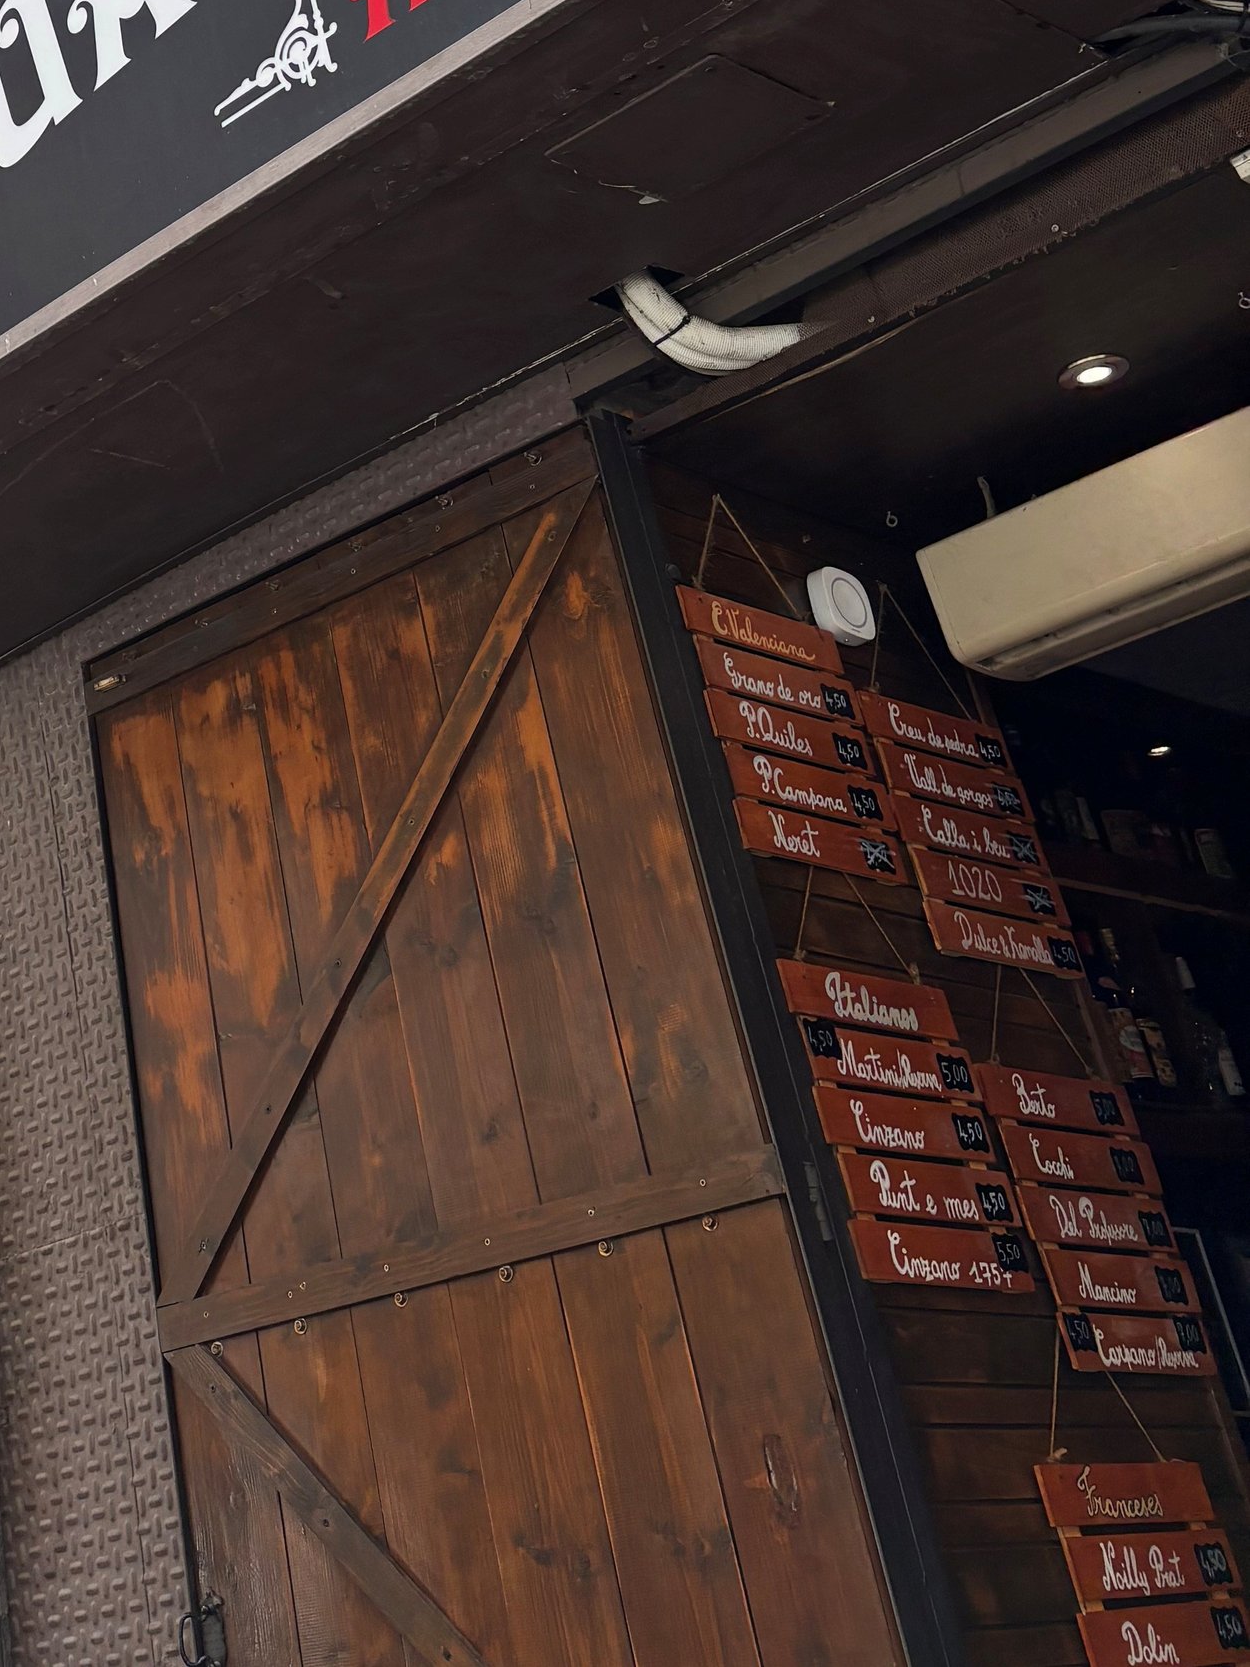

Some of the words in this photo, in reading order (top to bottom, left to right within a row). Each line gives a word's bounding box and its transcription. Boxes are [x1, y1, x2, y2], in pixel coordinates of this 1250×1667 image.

[777, 674, 795, 701] de
[799, 690, 821, 709] oro
[825, 692, 848, 711] 4,50
[926, 717, 945, 748] de
[838, 740, 860, 761] 4,50
[979, 741, 1002, 760] 4,50
[938, 764, 957, 798] de
[852, 794, 876, 814] 4,50
[768, 810, 821, 858] Neret
[970, 830, 982, 854] i
[948, 859, 1002, 903] 1020
[954, 910, 1000, 955] Dulce
[825, 971, 919, 1031] Italianos
[941, 1061, 968, 1086] 5,00
[850, 1099, 925, 1150] Cinzano
[958, 1119, 983, 1145] 4,50
[870, 1160, 921, 1212] Punt
[925, 1194, 938, 1215] e
[943, 1196, 979, 1221] mes
[981, 1192, 1006, 1217] 4,50
[1049, 1195, 1082, 1239] Del
[887, 1229, 961, 1282] Cinzano
[996, 1241, 1020, 1265] 5,50
[1077, 1465, 1164, 1519] Franceses
[1149, 1544, 1185, 1588] Prat
[1121, 1620, 1181, 1667] Dolin
